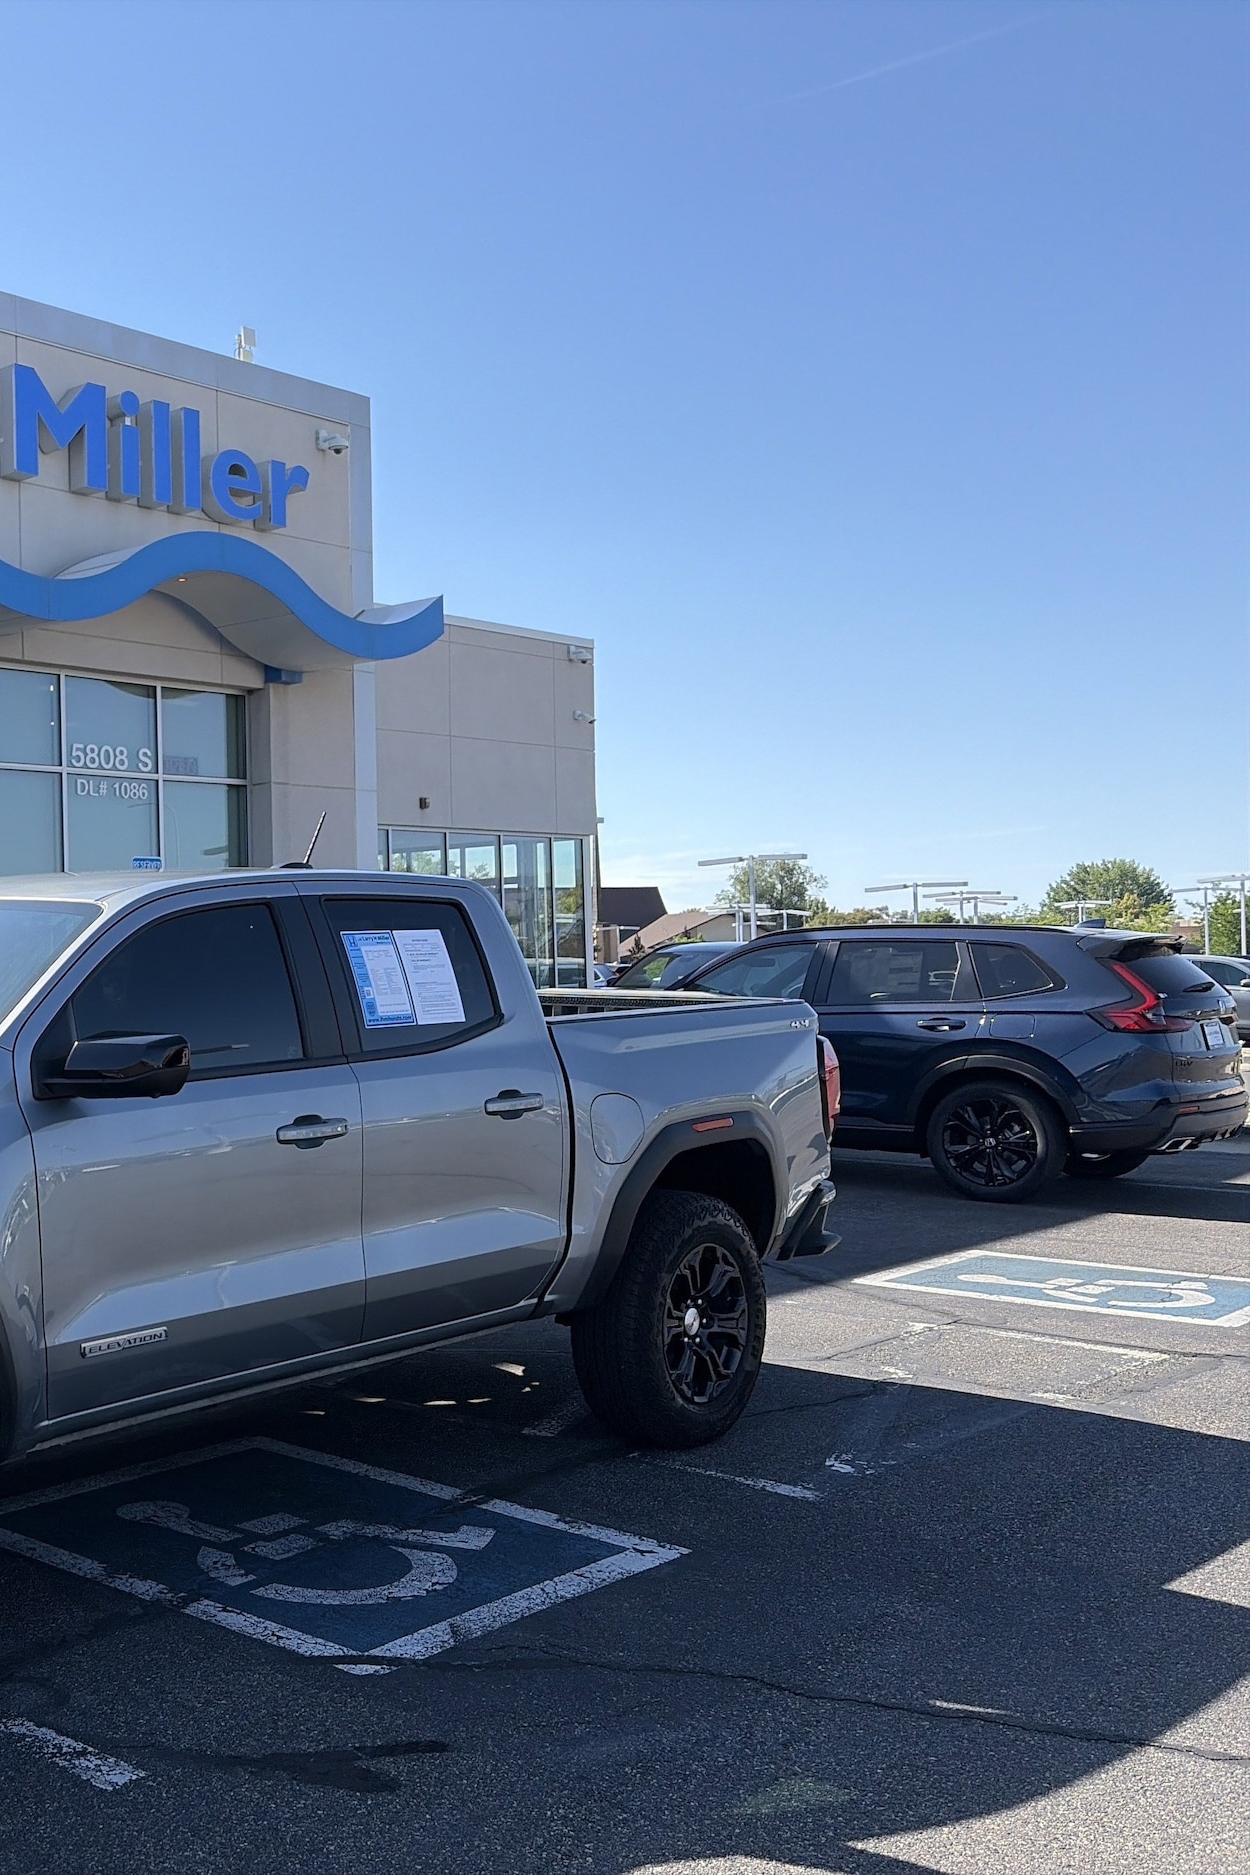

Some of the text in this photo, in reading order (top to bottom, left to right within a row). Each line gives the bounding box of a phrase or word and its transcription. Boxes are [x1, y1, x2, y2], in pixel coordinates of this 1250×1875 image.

[71, 743, 153, 772] 5808 S
[76, 779, 149, 800] DL# 1086
[89, 1332, 163, 1354] ELEVATION
